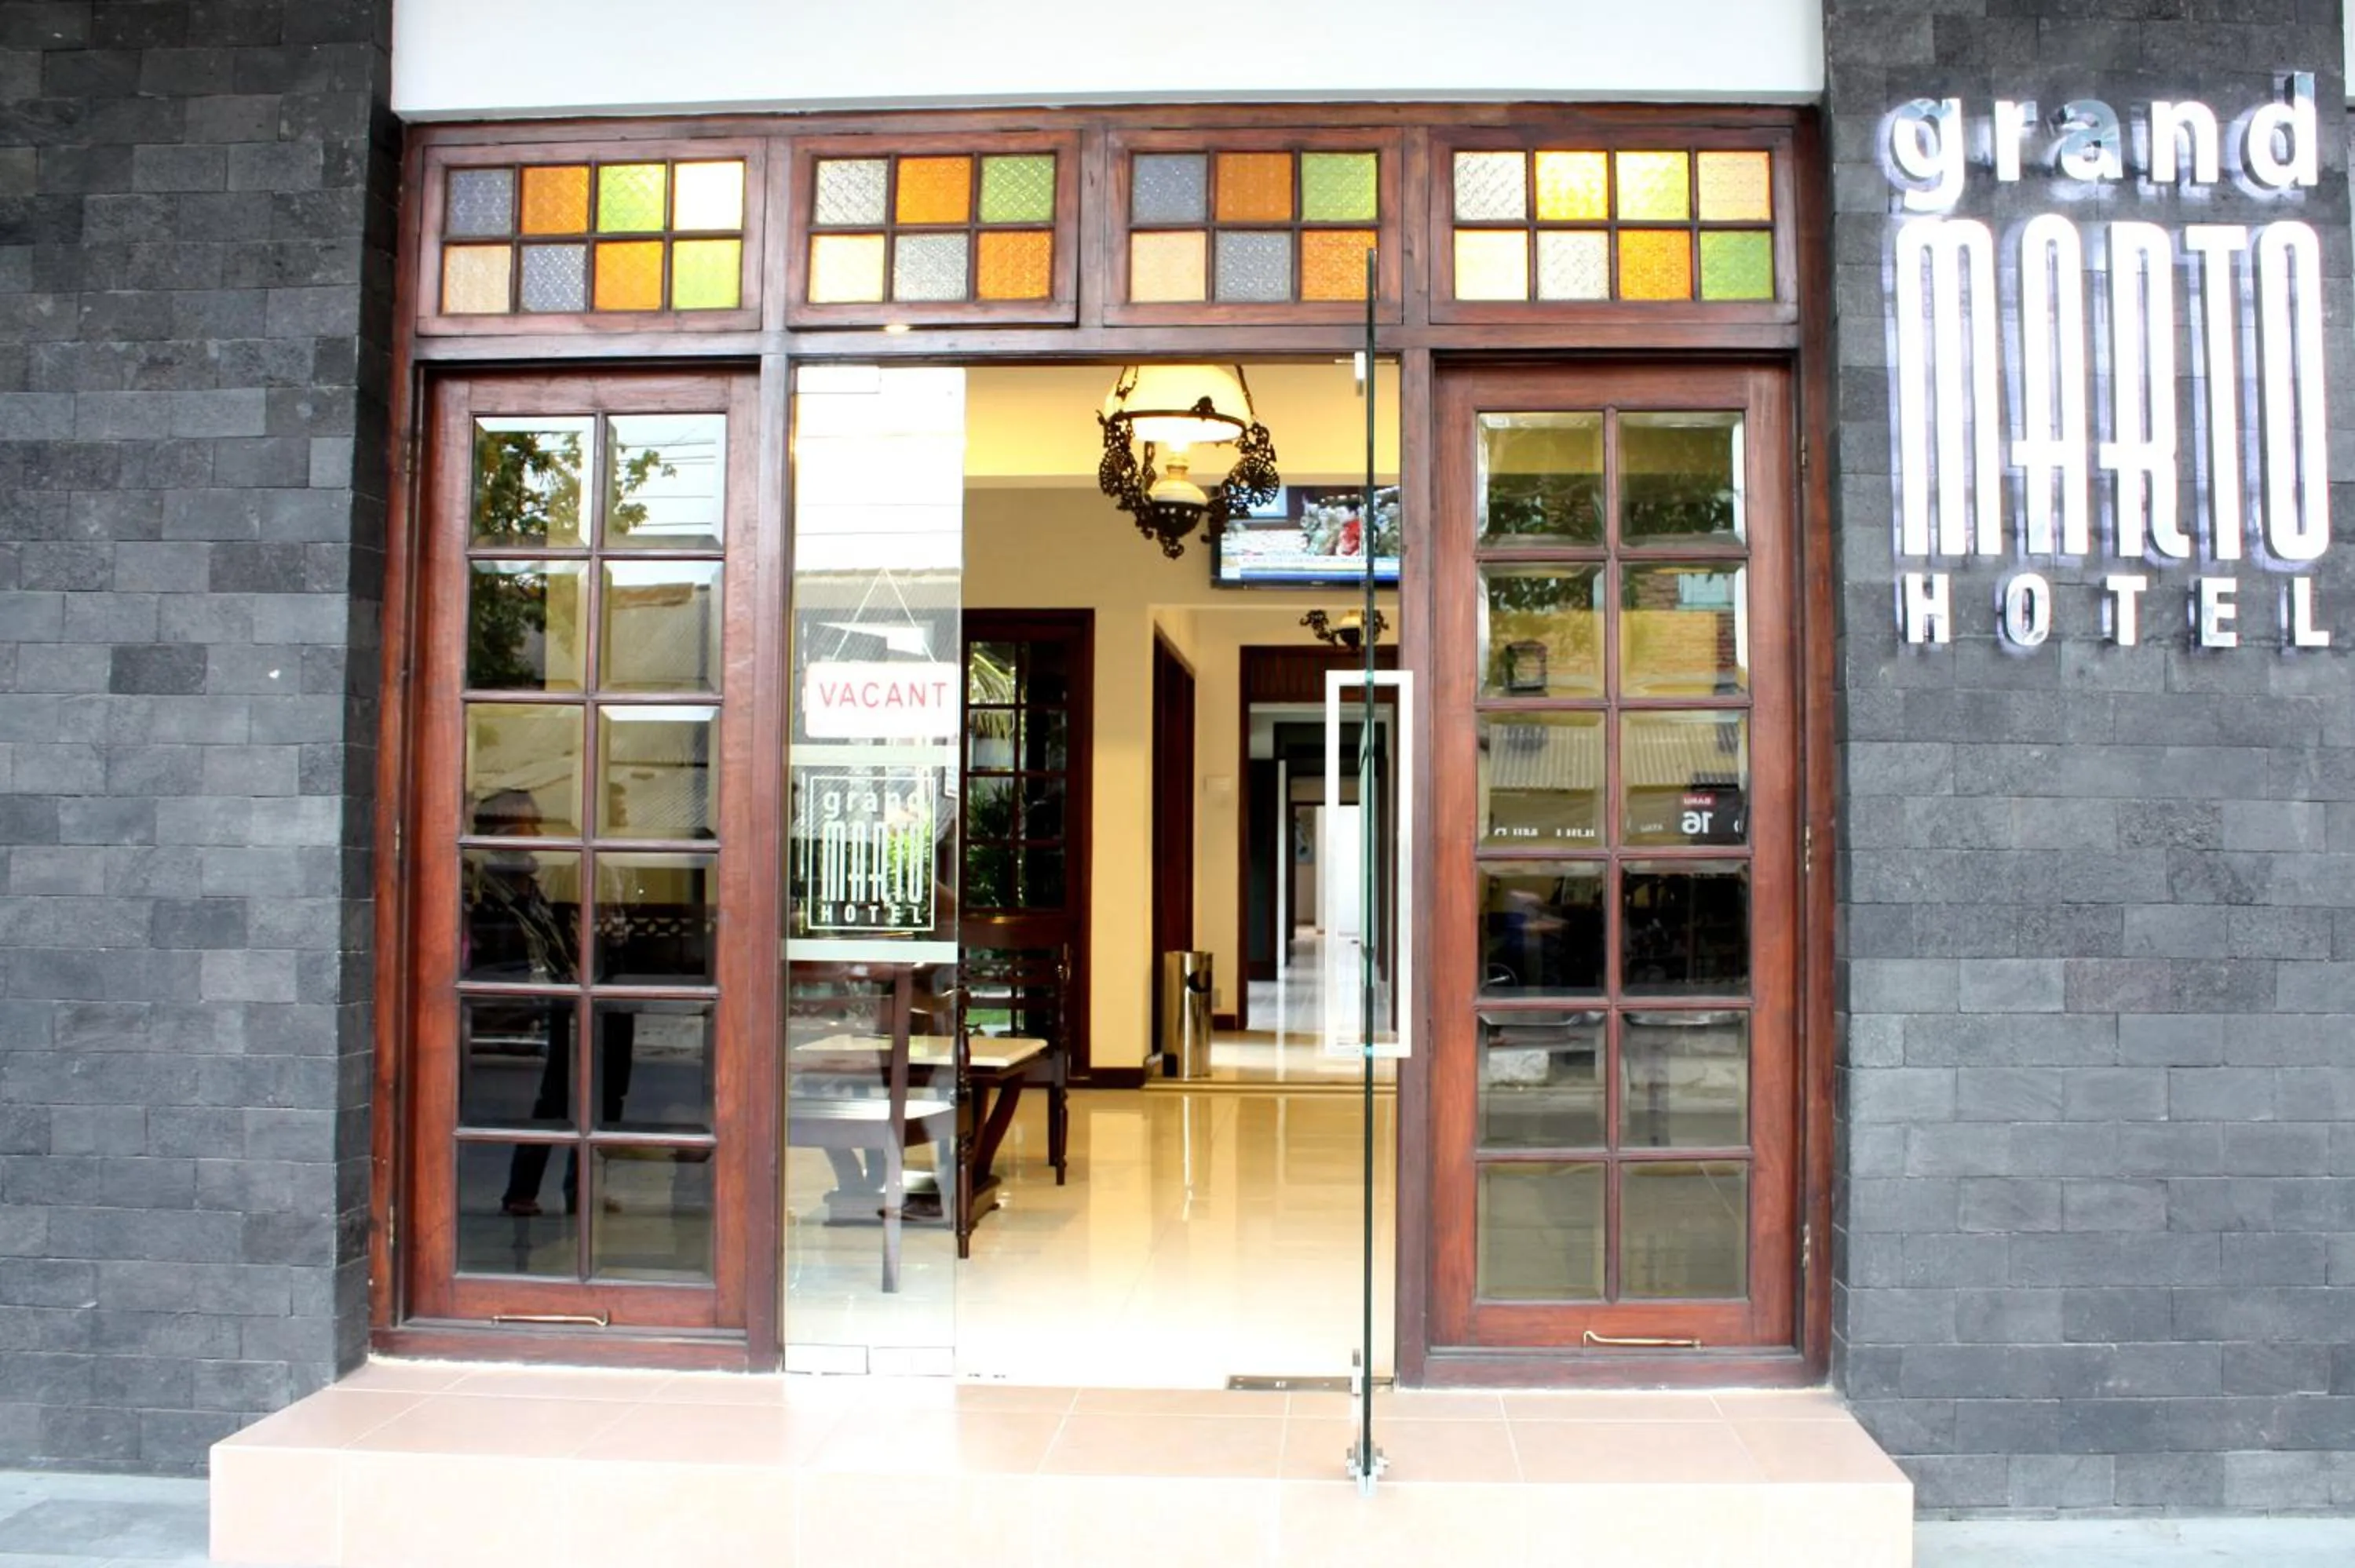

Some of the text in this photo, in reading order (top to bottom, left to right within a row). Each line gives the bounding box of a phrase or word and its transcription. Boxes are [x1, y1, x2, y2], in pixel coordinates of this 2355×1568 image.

[1886, 71, 2318, 210] grand
[1903, 573, 2330, 647] HOTEL
[820, 682, 947, 707] VACANT
[823, 787, 924, 819] grand
[821, 905, 922, 924] HOTEL
